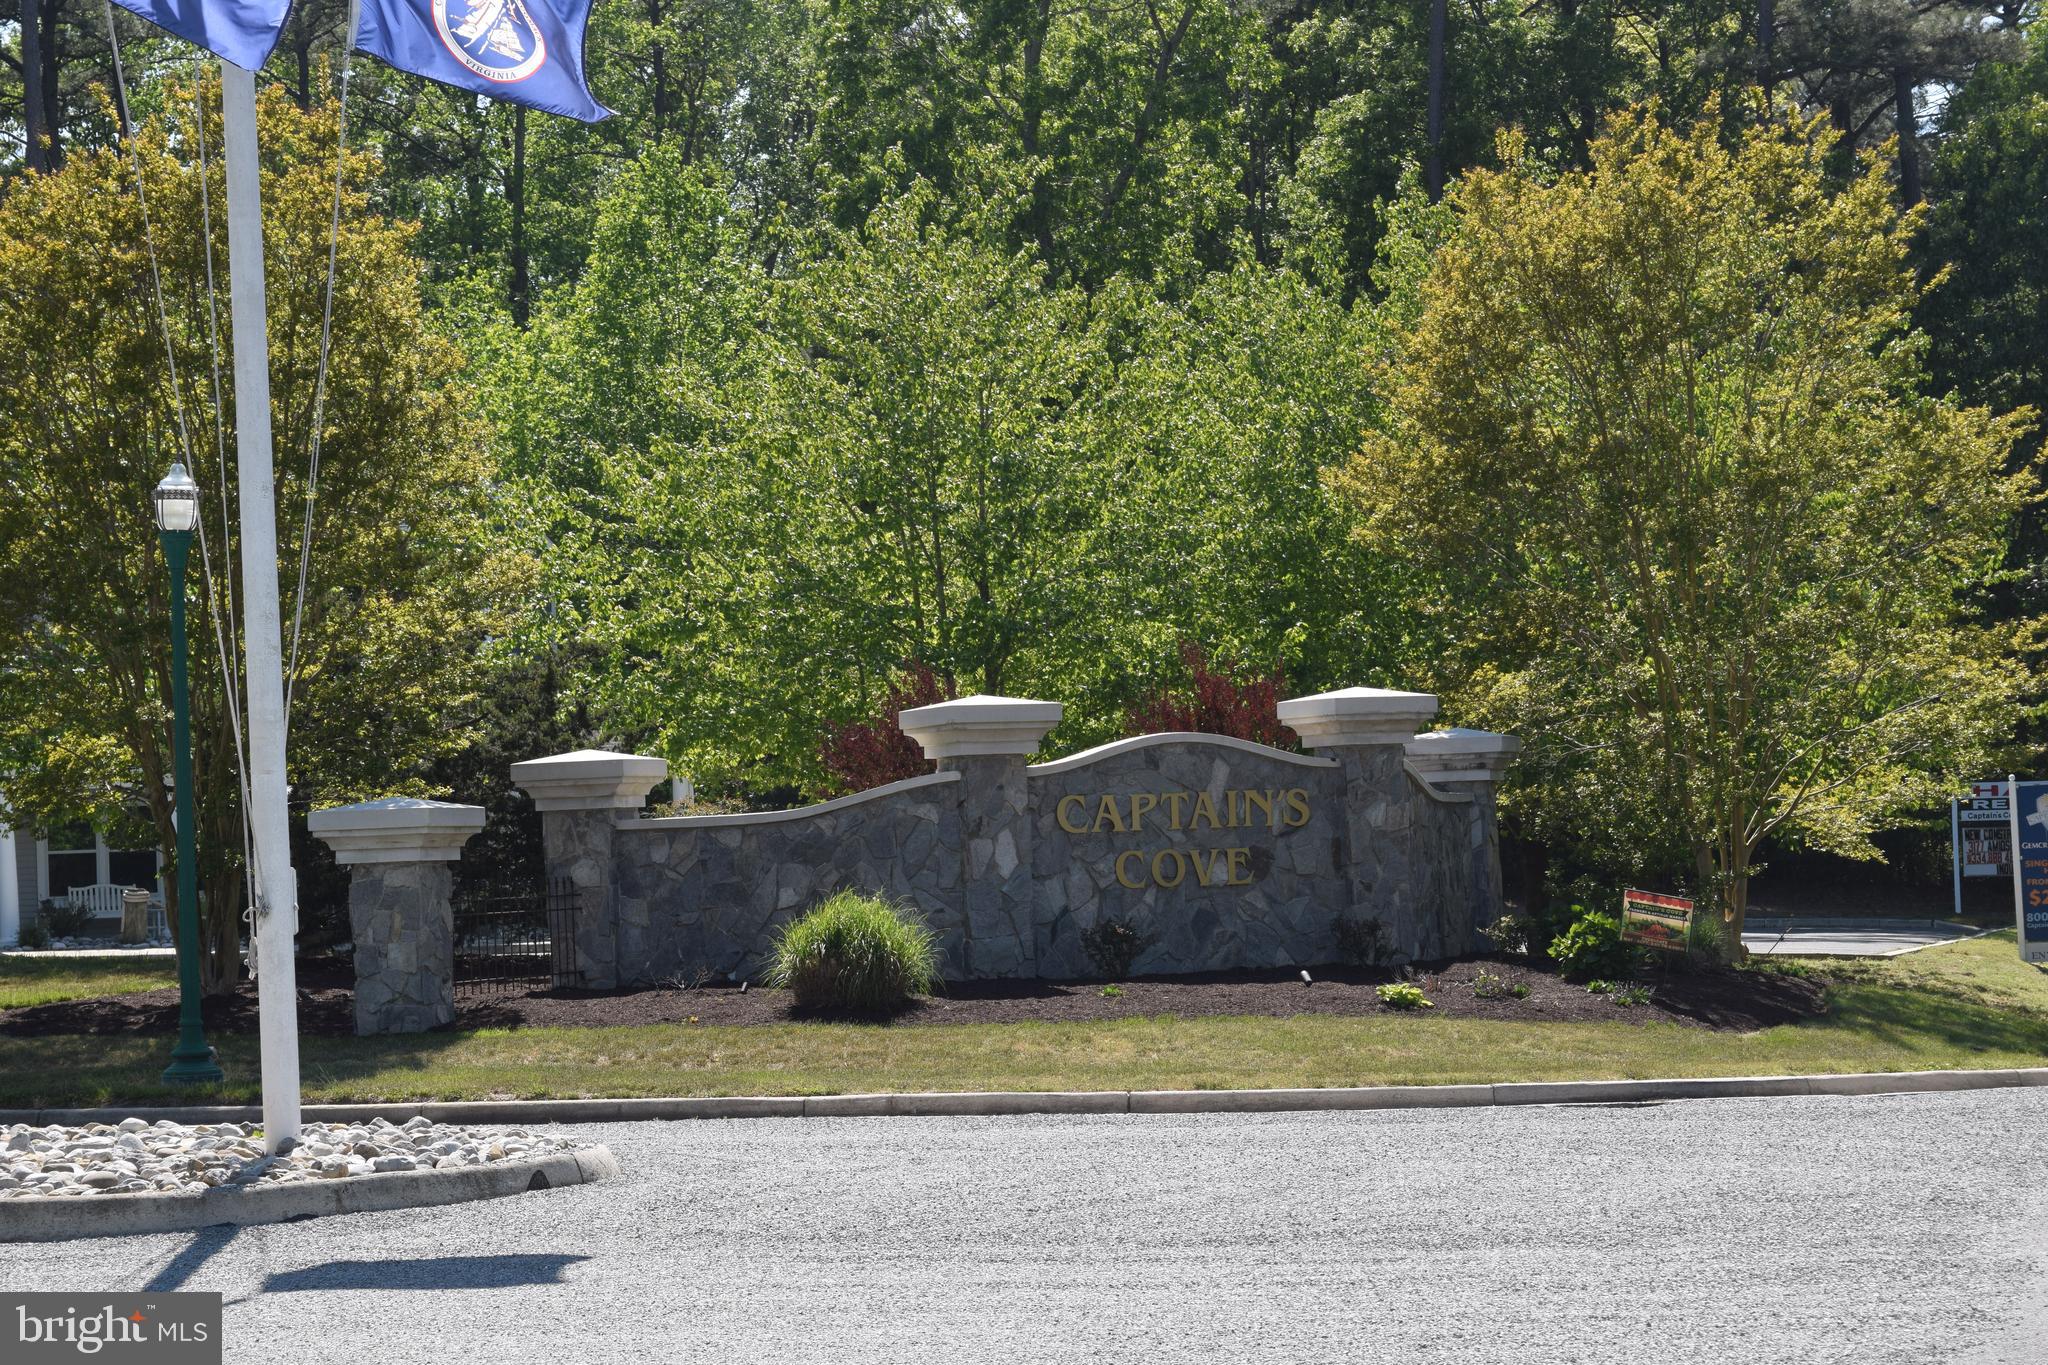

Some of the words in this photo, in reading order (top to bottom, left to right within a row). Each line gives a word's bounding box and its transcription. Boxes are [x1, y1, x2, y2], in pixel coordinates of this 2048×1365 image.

[465, 58, 517, 80] VIRGINIA
[1056, 787, 1311, 833] CAPTAIN'S
[1967, 811, 2002, 821] Captain's
[2003, 811, 2012, 819] C
[1115, 847, 1254, 889] COVE
